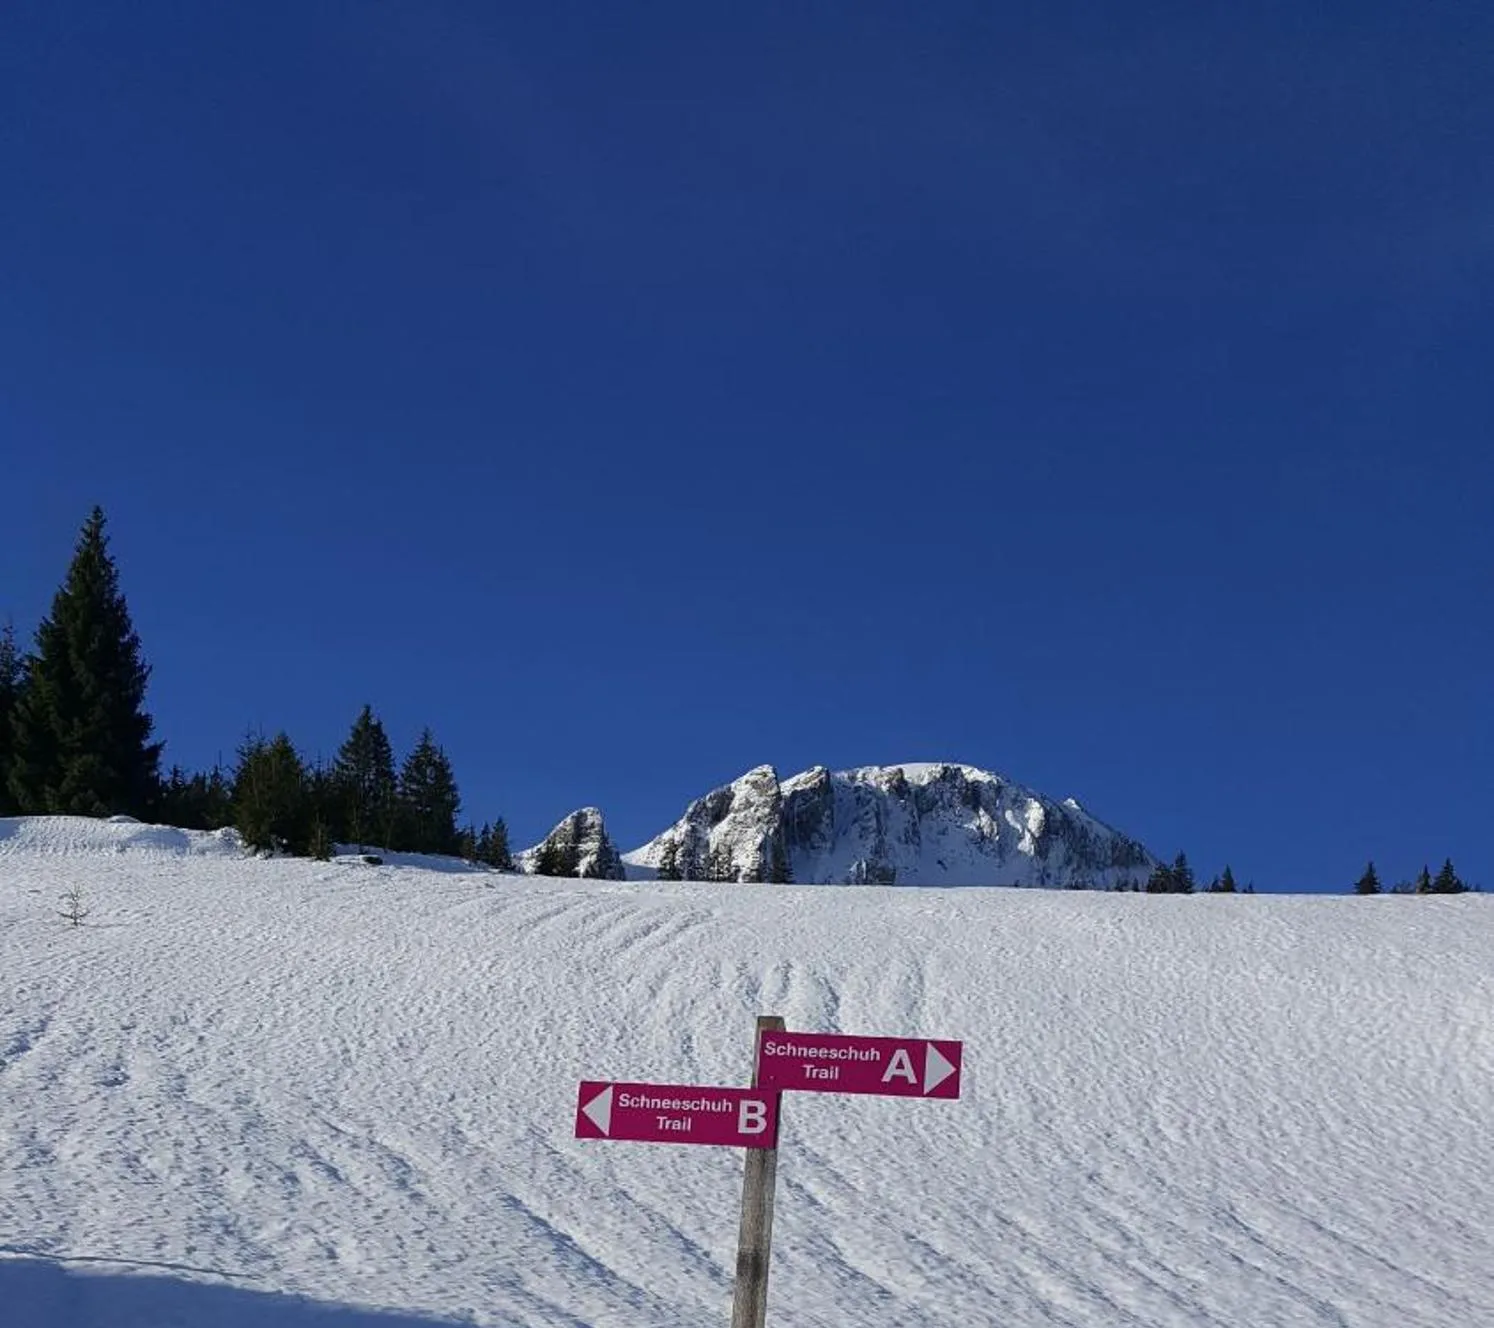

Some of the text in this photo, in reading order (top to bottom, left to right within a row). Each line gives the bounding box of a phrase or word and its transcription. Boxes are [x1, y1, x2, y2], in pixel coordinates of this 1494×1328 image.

[764, 1041, 880, 1061] Schneeschuh
[803, 1065, 839, 1080] Trail
[881, 1049, 917, 1084] A
[618, 1093, 732, 1112] Schneeschuh
[656, 1116, 692, 1131] Trail
[737, 1100, 767, 1134] B
